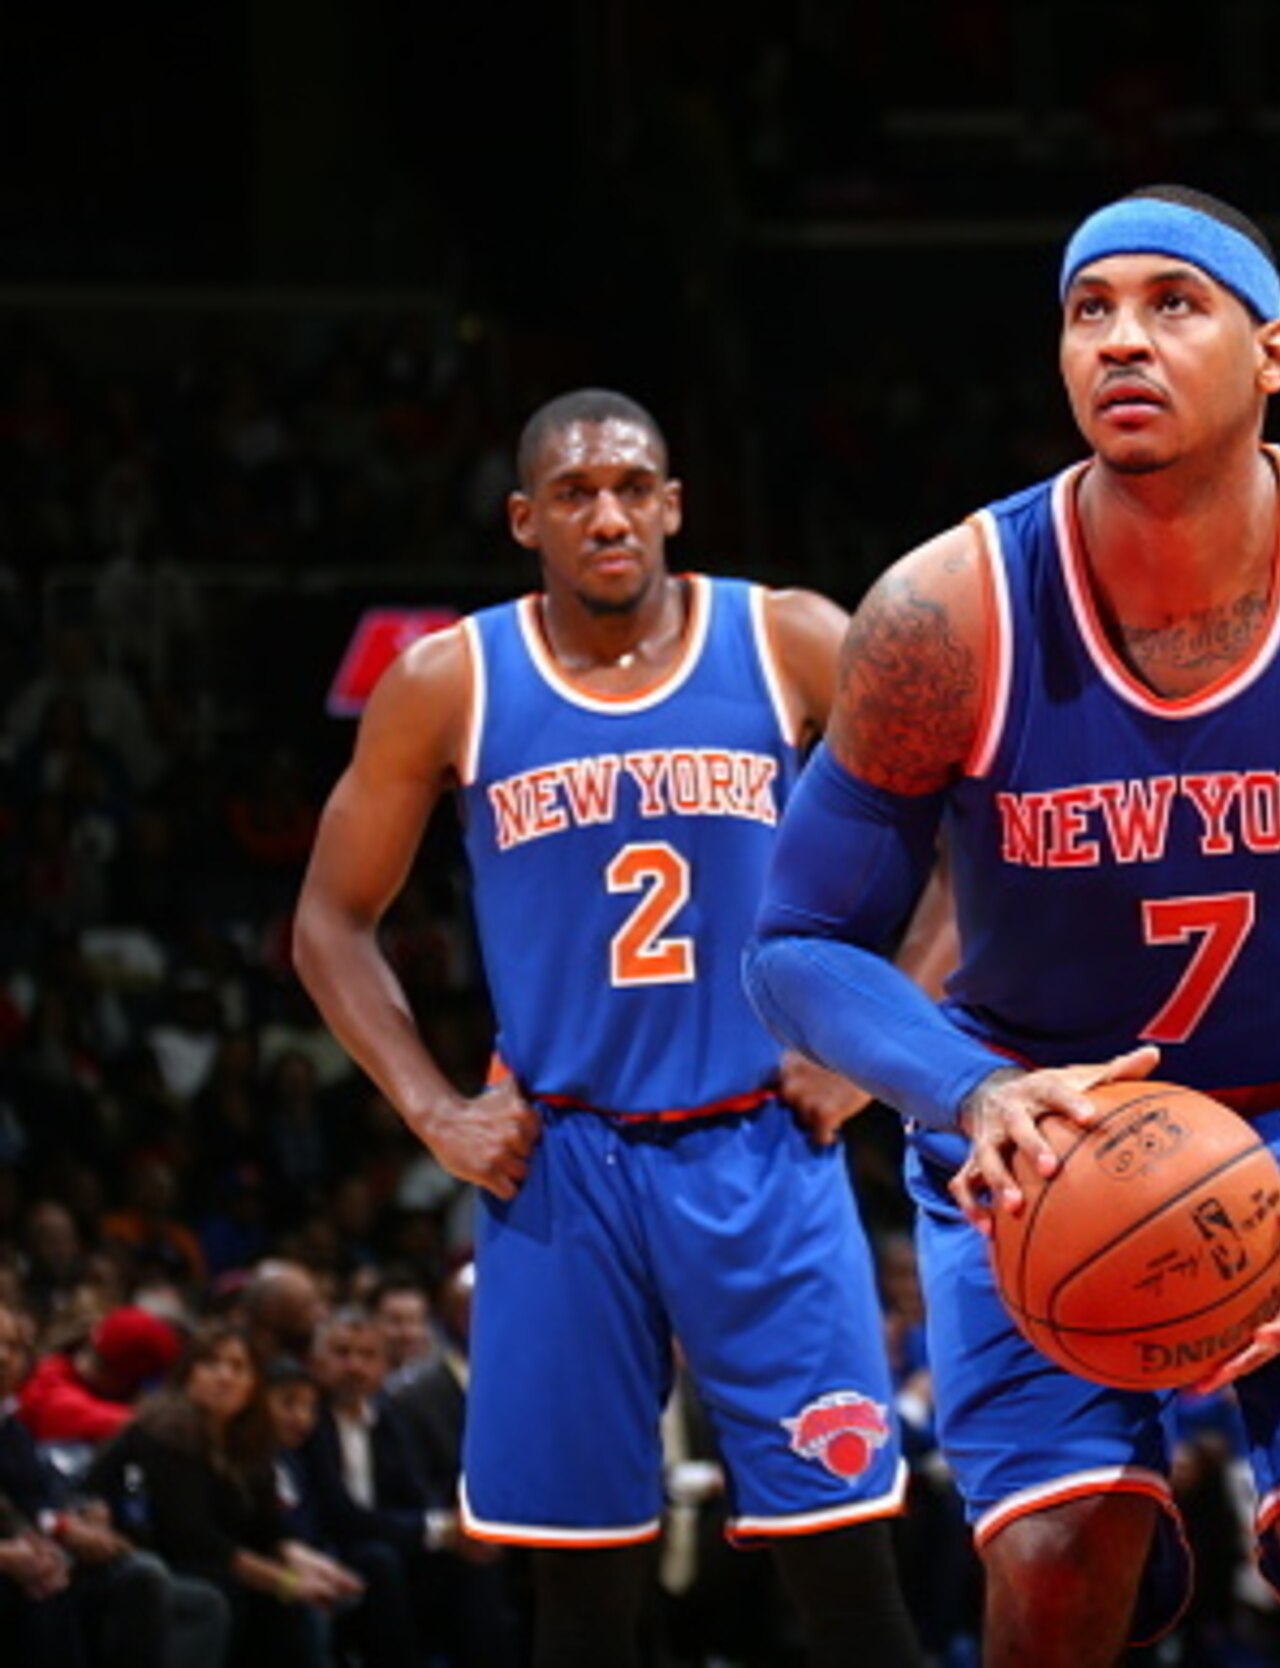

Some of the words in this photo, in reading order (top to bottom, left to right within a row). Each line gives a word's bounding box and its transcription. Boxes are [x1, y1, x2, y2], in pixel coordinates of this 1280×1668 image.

[489, 754, 620, 850] NEW
[624, 748, 777, 826] YORK
[997, 776, 1176, 867] NEW
[606, 840, 694, 987] 2
[1138, 891, 1255, 1043] 7
